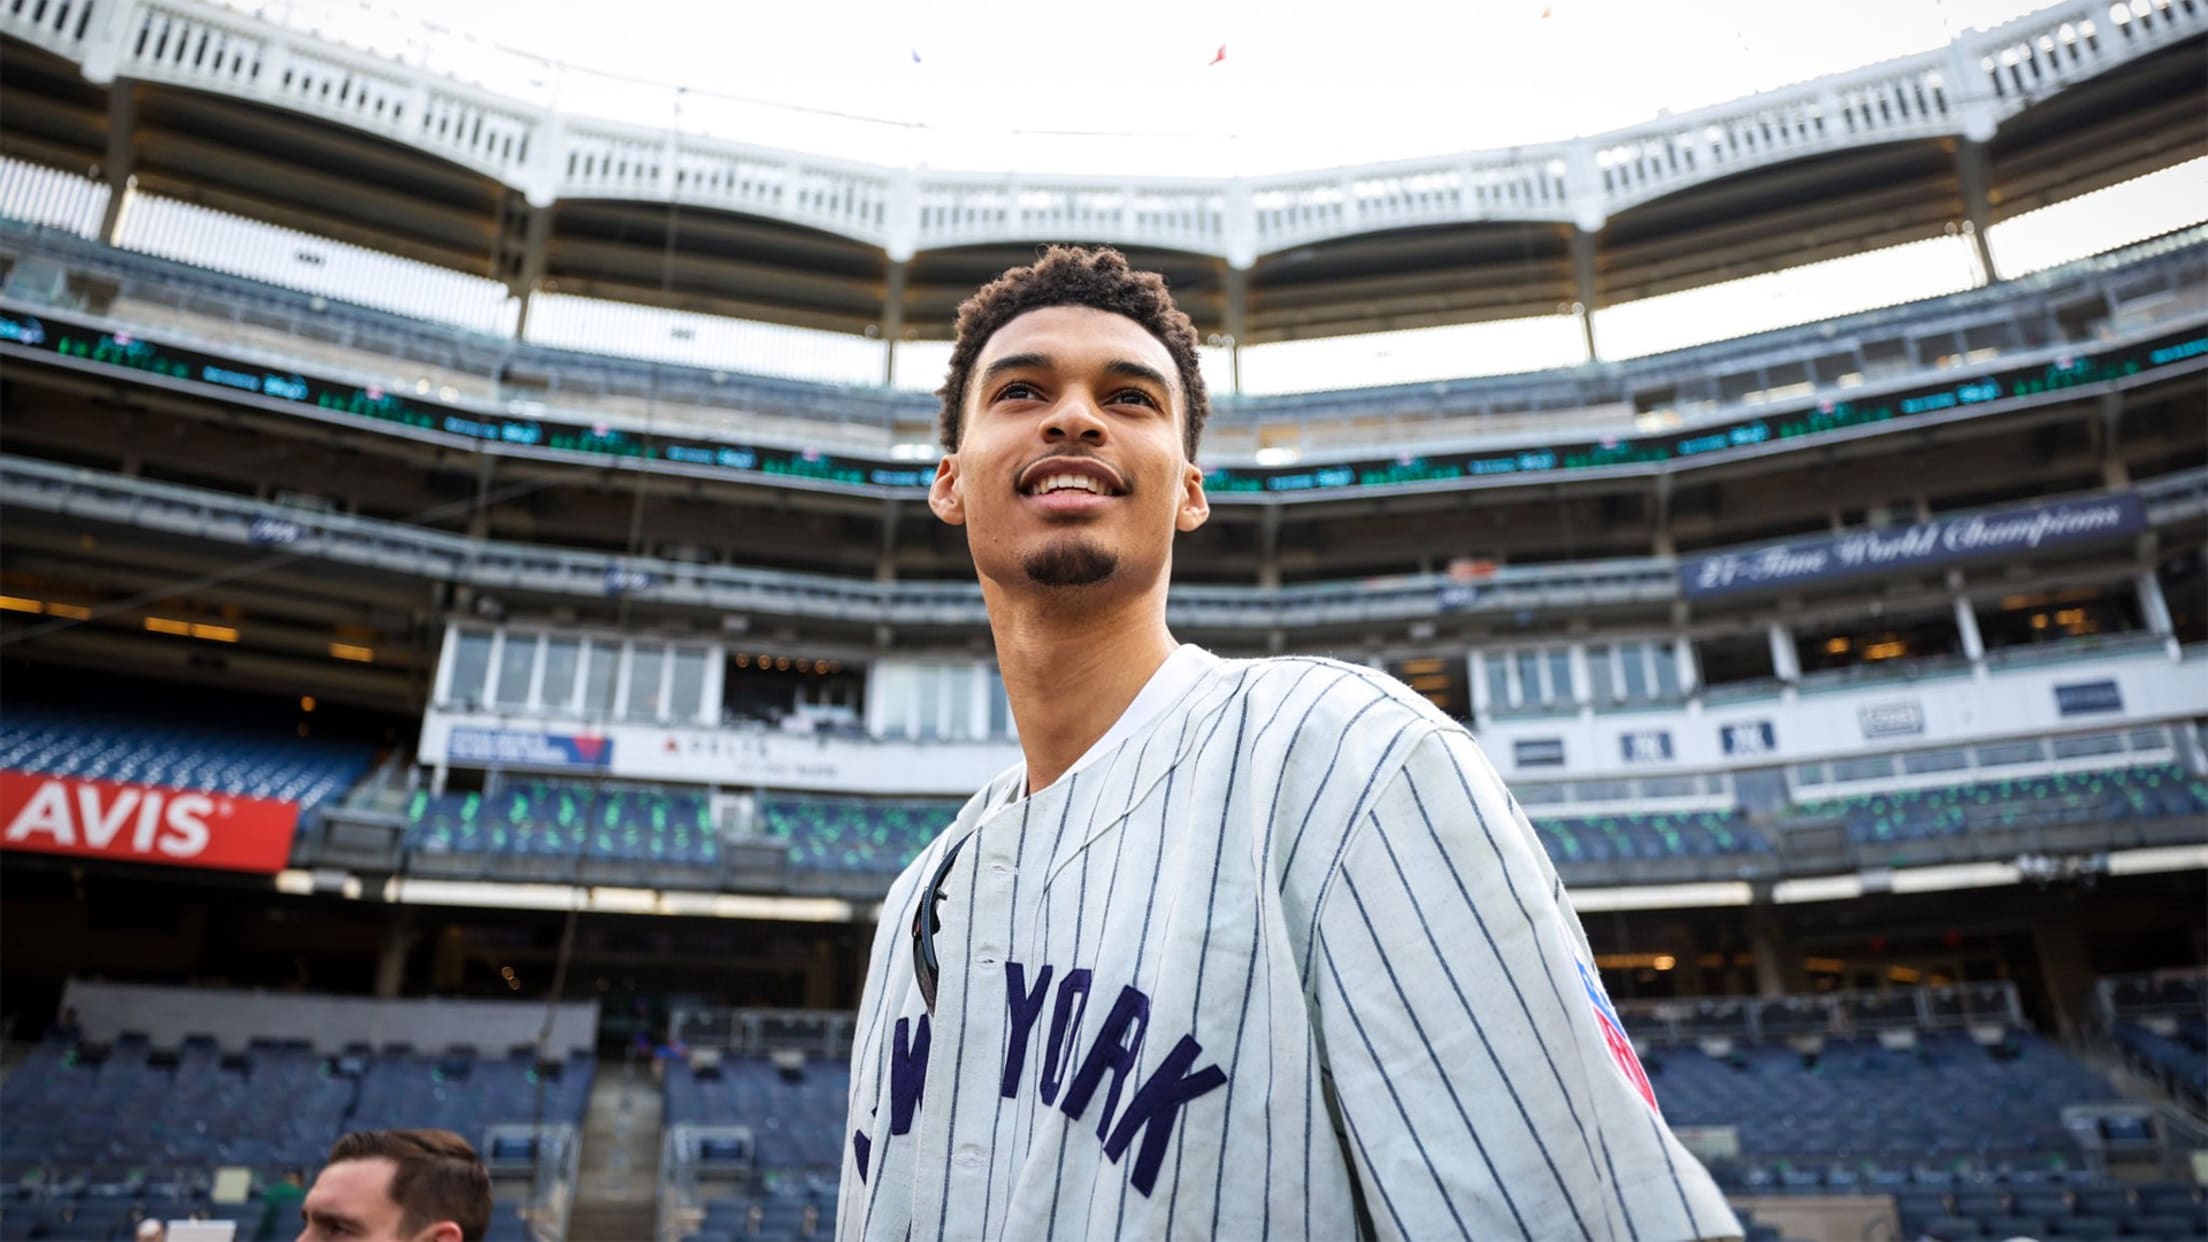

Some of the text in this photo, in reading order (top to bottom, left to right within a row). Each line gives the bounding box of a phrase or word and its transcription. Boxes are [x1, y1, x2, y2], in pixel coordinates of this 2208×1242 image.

[1834, 522, 1939, 566] World
[1944, 505, 2120, 548] Champions
[5, 780, 214, 858] AVIS
[1001, 961, 1228, 1198] YORK
